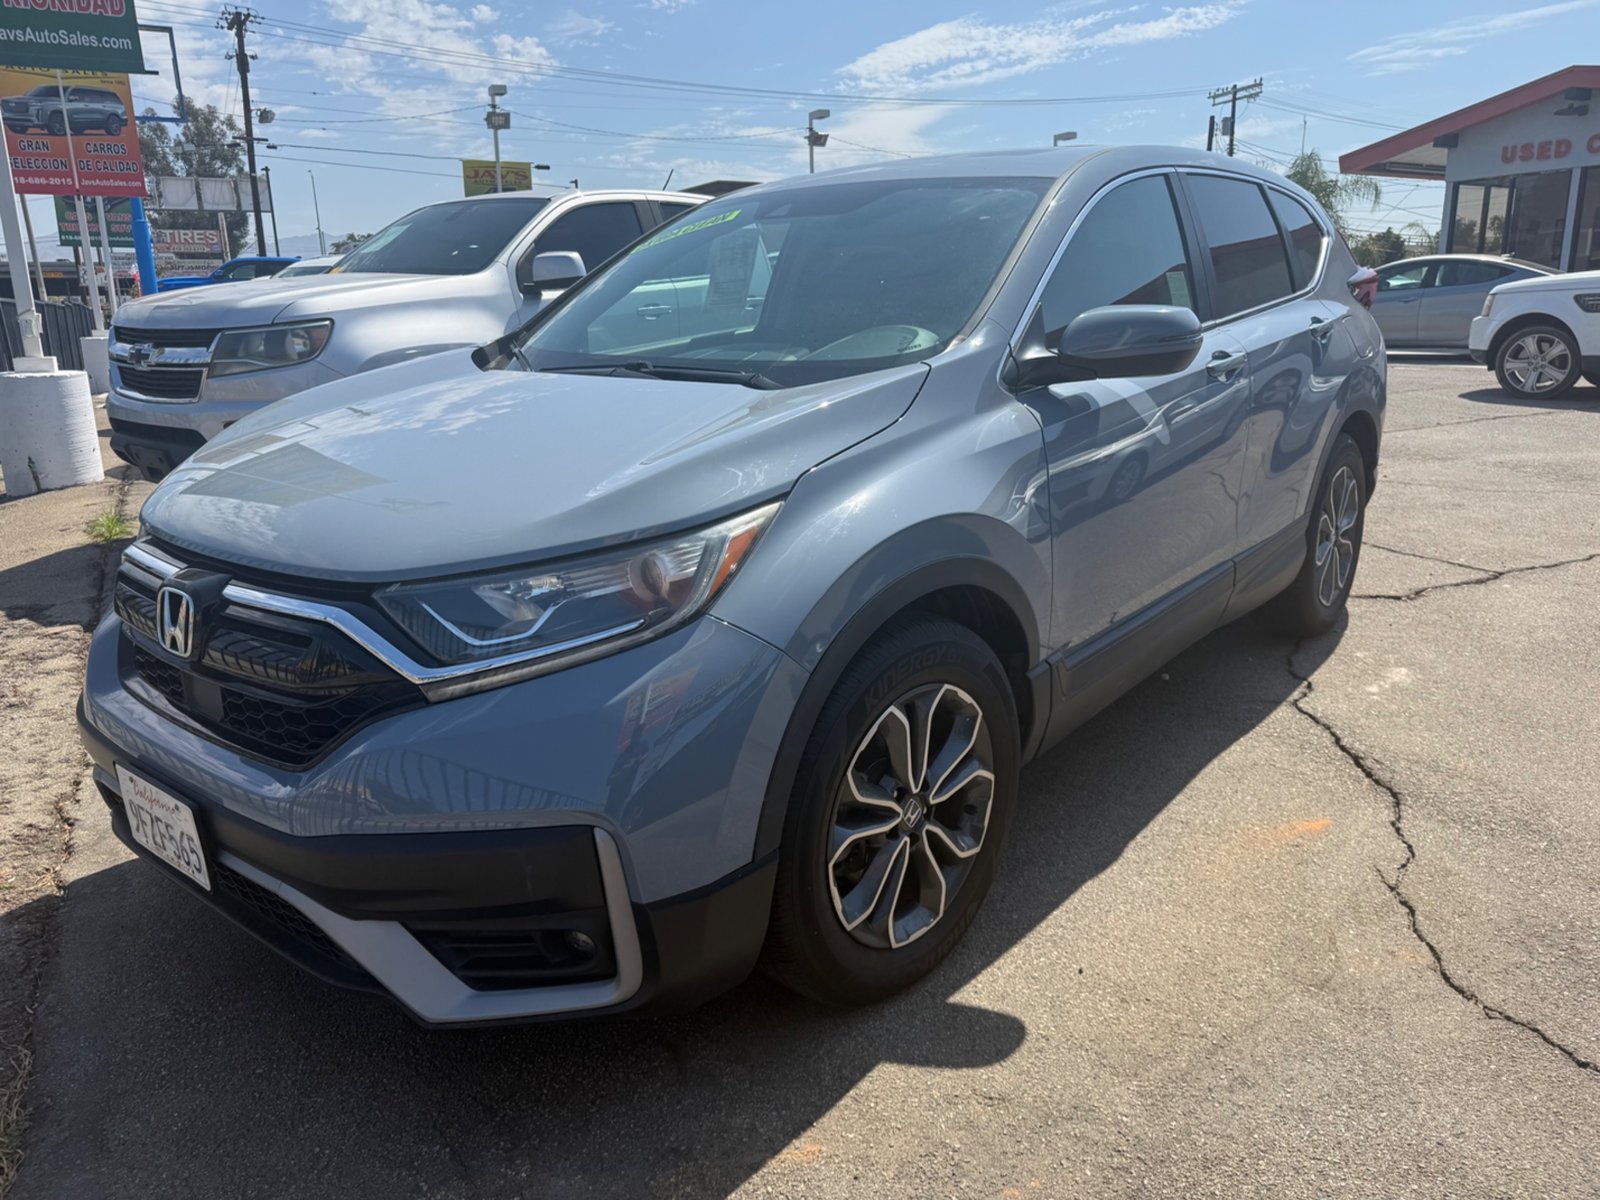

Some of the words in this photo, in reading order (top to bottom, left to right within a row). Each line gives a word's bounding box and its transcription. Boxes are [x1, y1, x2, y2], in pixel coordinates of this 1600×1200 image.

[18, 139, 51, 152] GRAN
[85, 142, 128, 155] CARROS
[1501, 138, 1573, 165] USED
[79, 160, 92, 171] DE
[95, 161, 139, 173] CALIDAD
[165, 230, 218, 244] TIRES
[129, 798, 203, 874] 9FZF565
